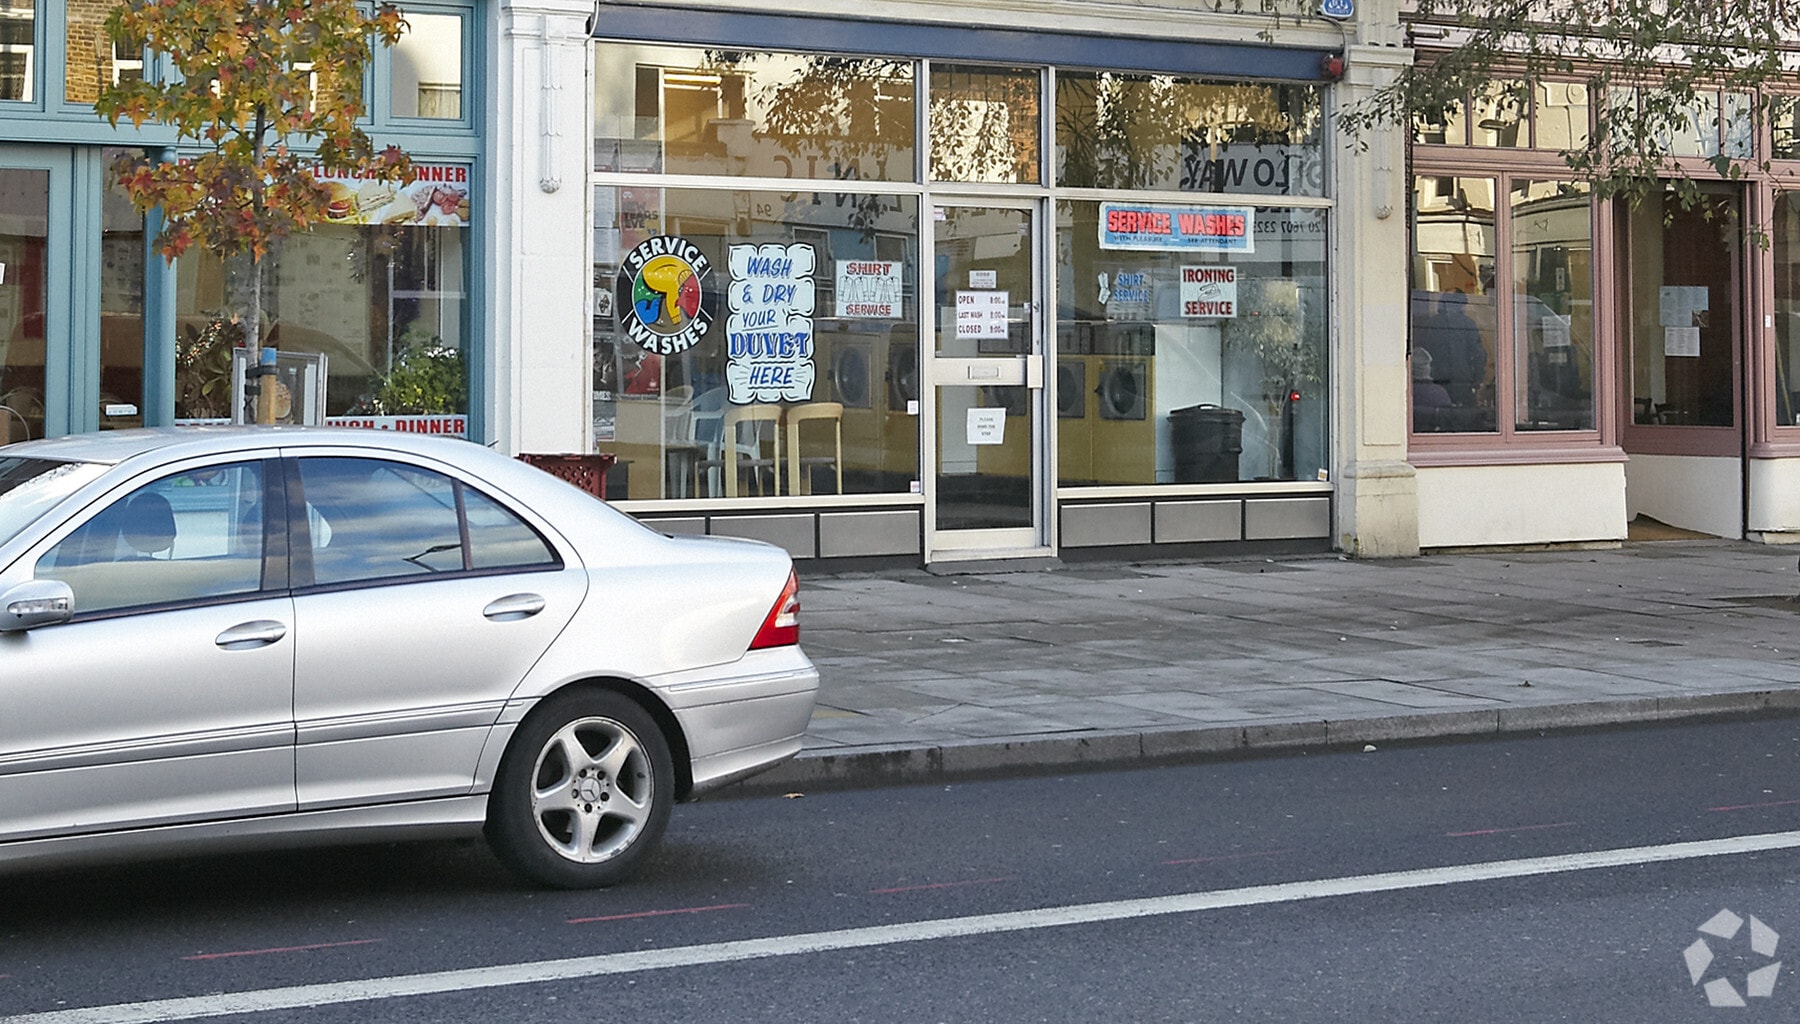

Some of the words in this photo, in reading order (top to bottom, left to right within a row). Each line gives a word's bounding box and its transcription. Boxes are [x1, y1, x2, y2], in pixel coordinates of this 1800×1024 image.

[1108, 211, 1171, 234] SERVICE
[1178, 213, 1245, 237] WASHES
[629, 237, 707, 272] SERVICE
[747, 256, 792, 276] WASH
[848, 262, 892, 275] SHIRT
[1118, 274, 1144, 286] SHIRT
[1182, 269, 1234, 283] IRONING
[743, 284, 754, 302] &
[762, 284, 795, 303] DRY
[958, 295, 975, 304] OPEN
[1114, 290, 1149, 302] SERVICE
[847, 304, 891, 315] SERVICE
[1185, 302, 1232, 315] SERVICE
[743, 309, 776, 327] YOUR
[628, 317, 708, 355] WASHES
[958, 325, 982, 333] CLOSED
[731, 333, 808, 358] DUVET
[750, 367, 795, 385] HERE
[395, 419, 465, 434] DINNER
